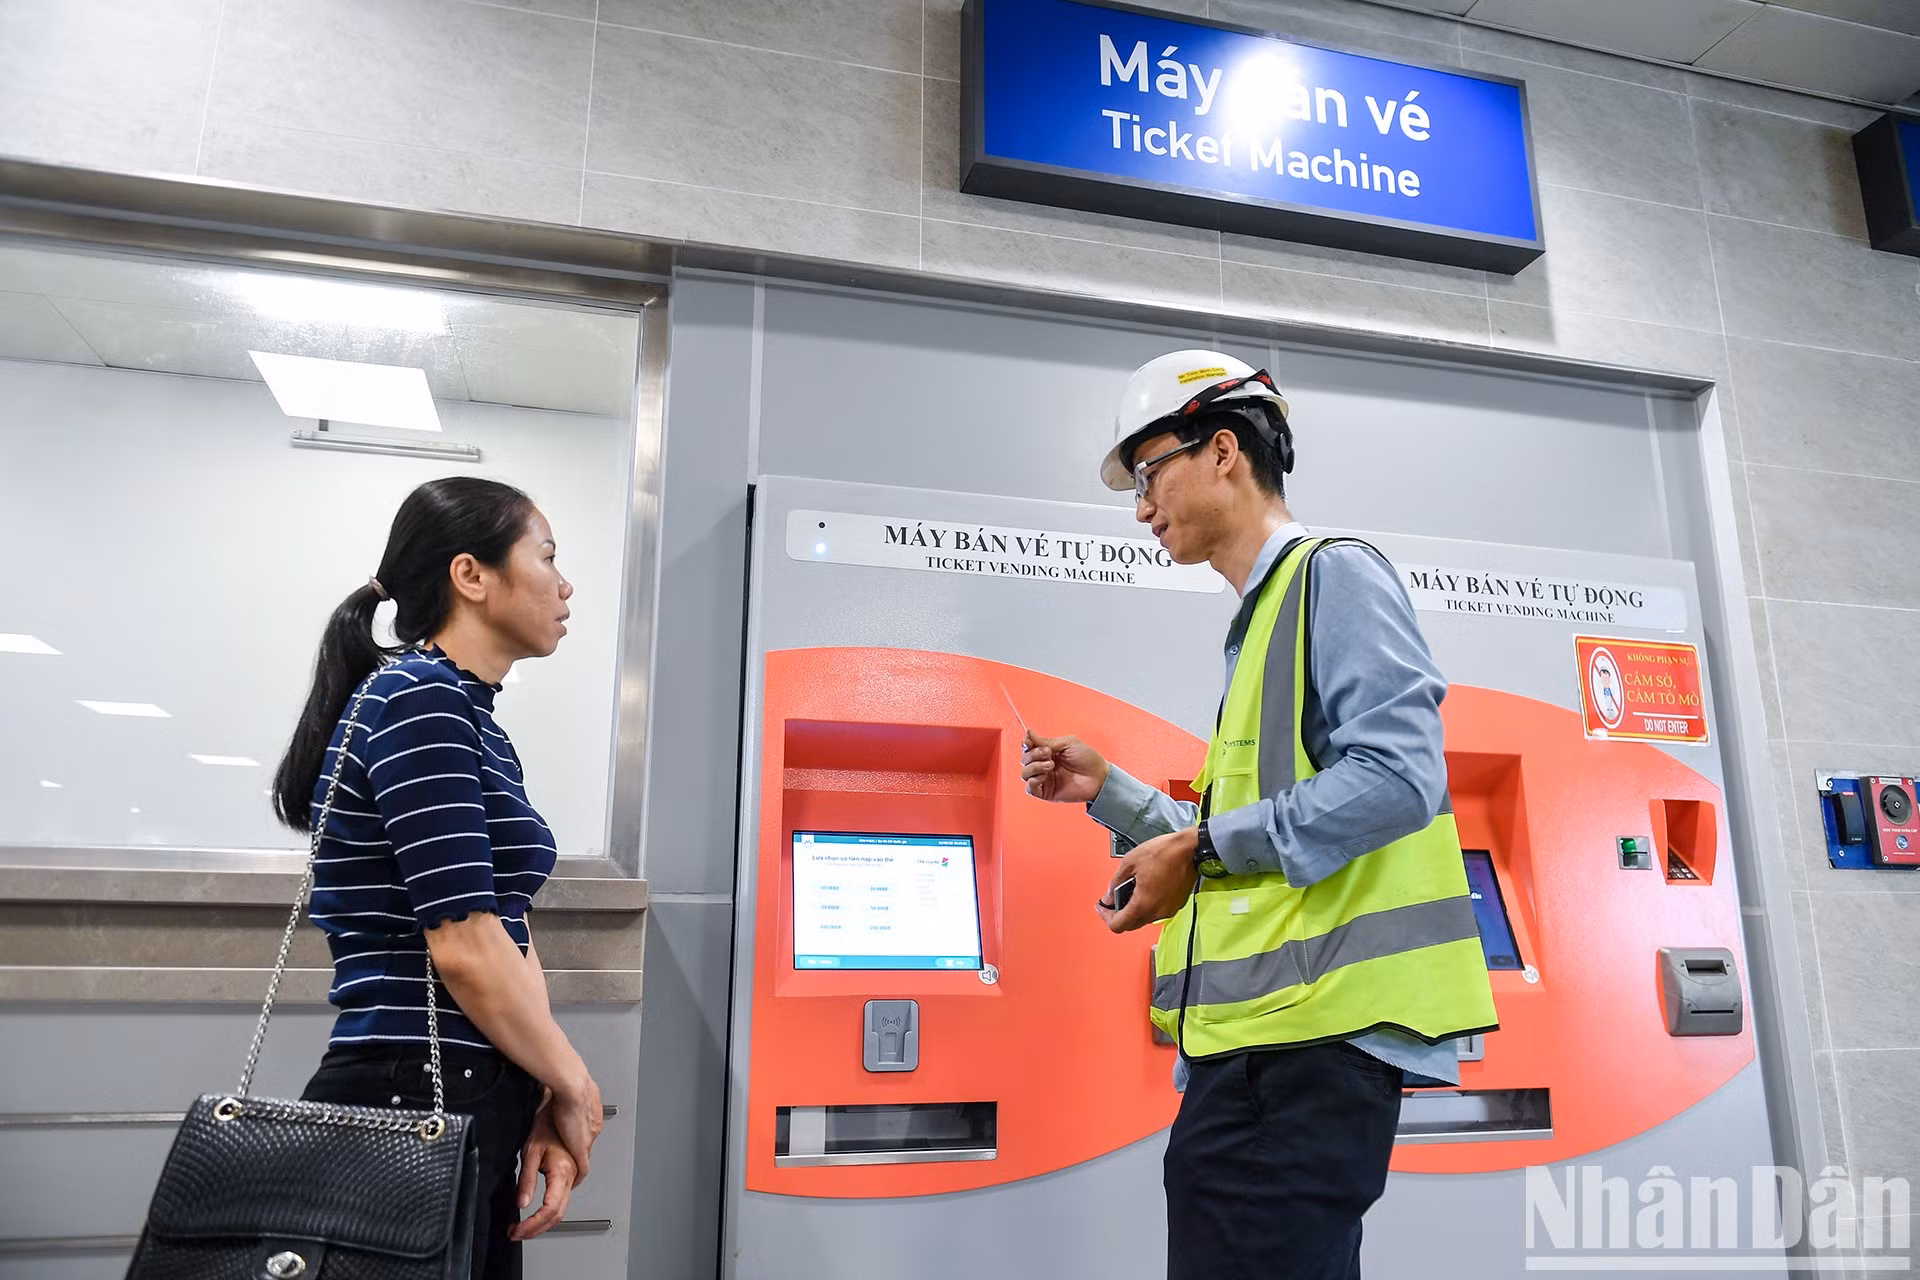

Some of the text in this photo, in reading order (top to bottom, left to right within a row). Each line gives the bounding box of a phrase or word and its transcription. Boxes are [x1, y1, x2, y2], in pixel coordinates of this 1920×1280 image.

[1100, 34, 1222, 116] Máy
[1365, 91, 1430, 141] vé
[1102, 109, 1421, 197] Ticket Machine
[884, 522, 1172, 568] MÁY BÁN VÉ TỰ ĐỘNG
[925, 555, 1135, 584] TICKET VENDING MACHINE
[1410, 568, 1643, 609] MÁY BÁN VÉ TỰ ĐỘNG
[1445, 599, 1616, 623] TICKET VENDING MACHINE
[1654, 719, 1667, 732] NOT
[1668, 720, 1689, 734] ENTER
